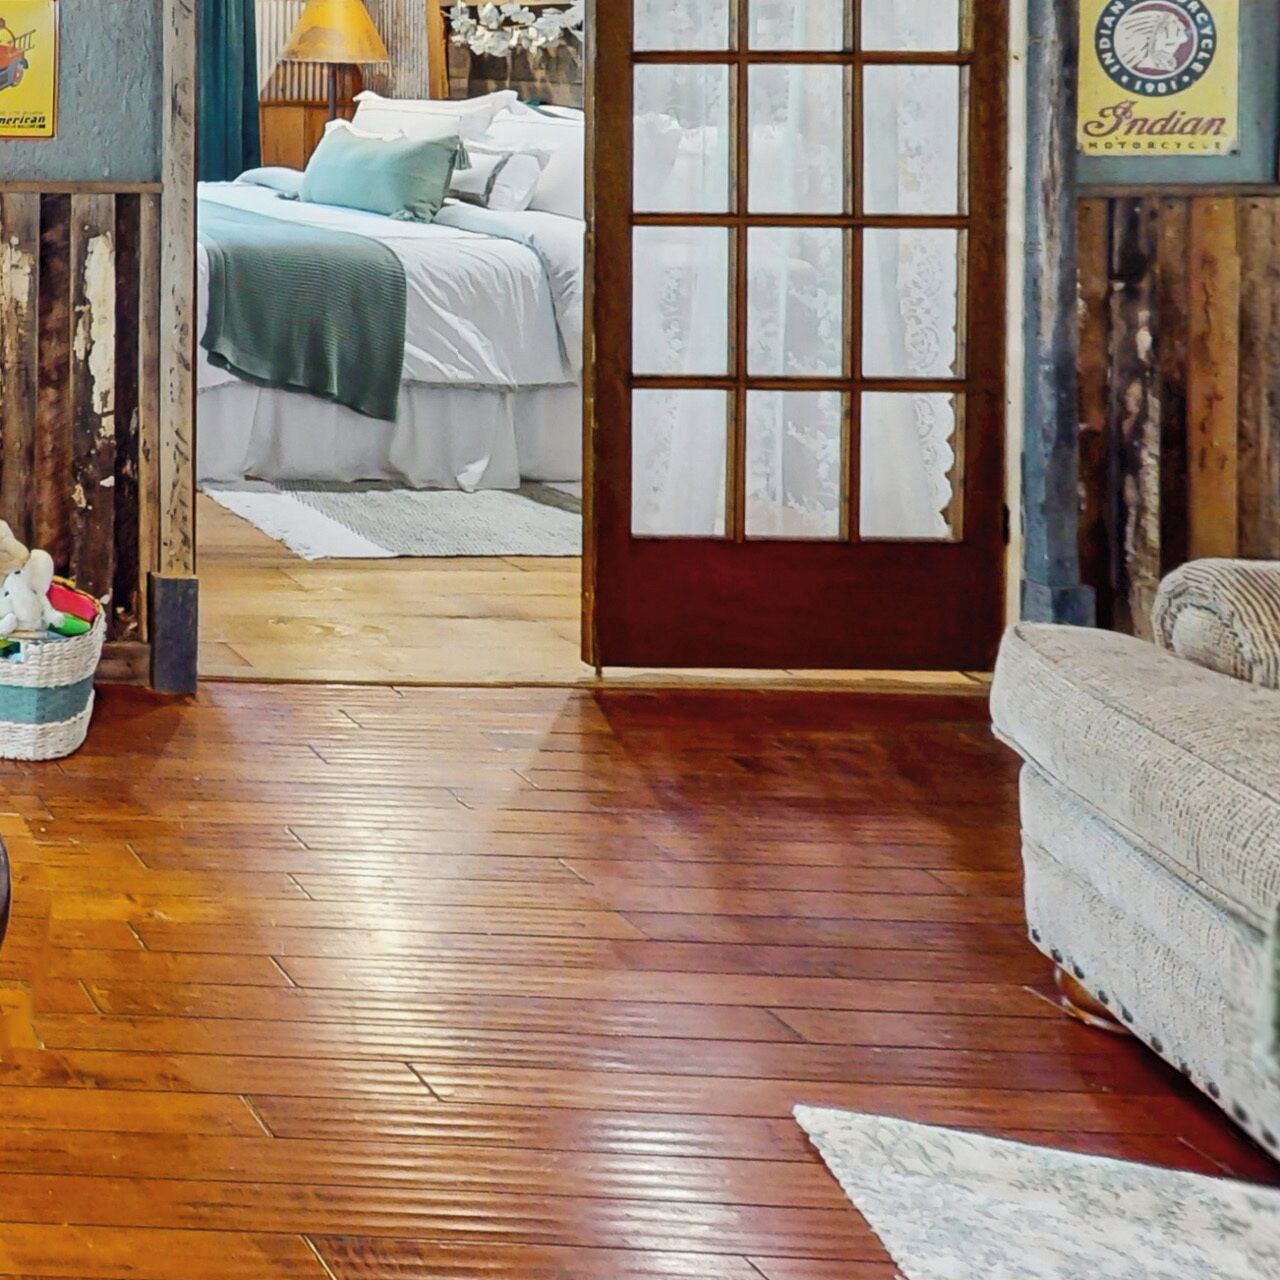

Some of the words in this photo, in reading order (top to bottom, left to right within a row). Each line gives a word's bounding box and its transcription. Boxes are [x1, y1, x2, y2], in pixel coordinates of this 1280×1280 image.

[1099, 0, 1125, 74] INDIAN
[1083, 100, 1226, 137] Indian
[1088, 142, 1221, 150] MOTORCYCLE
